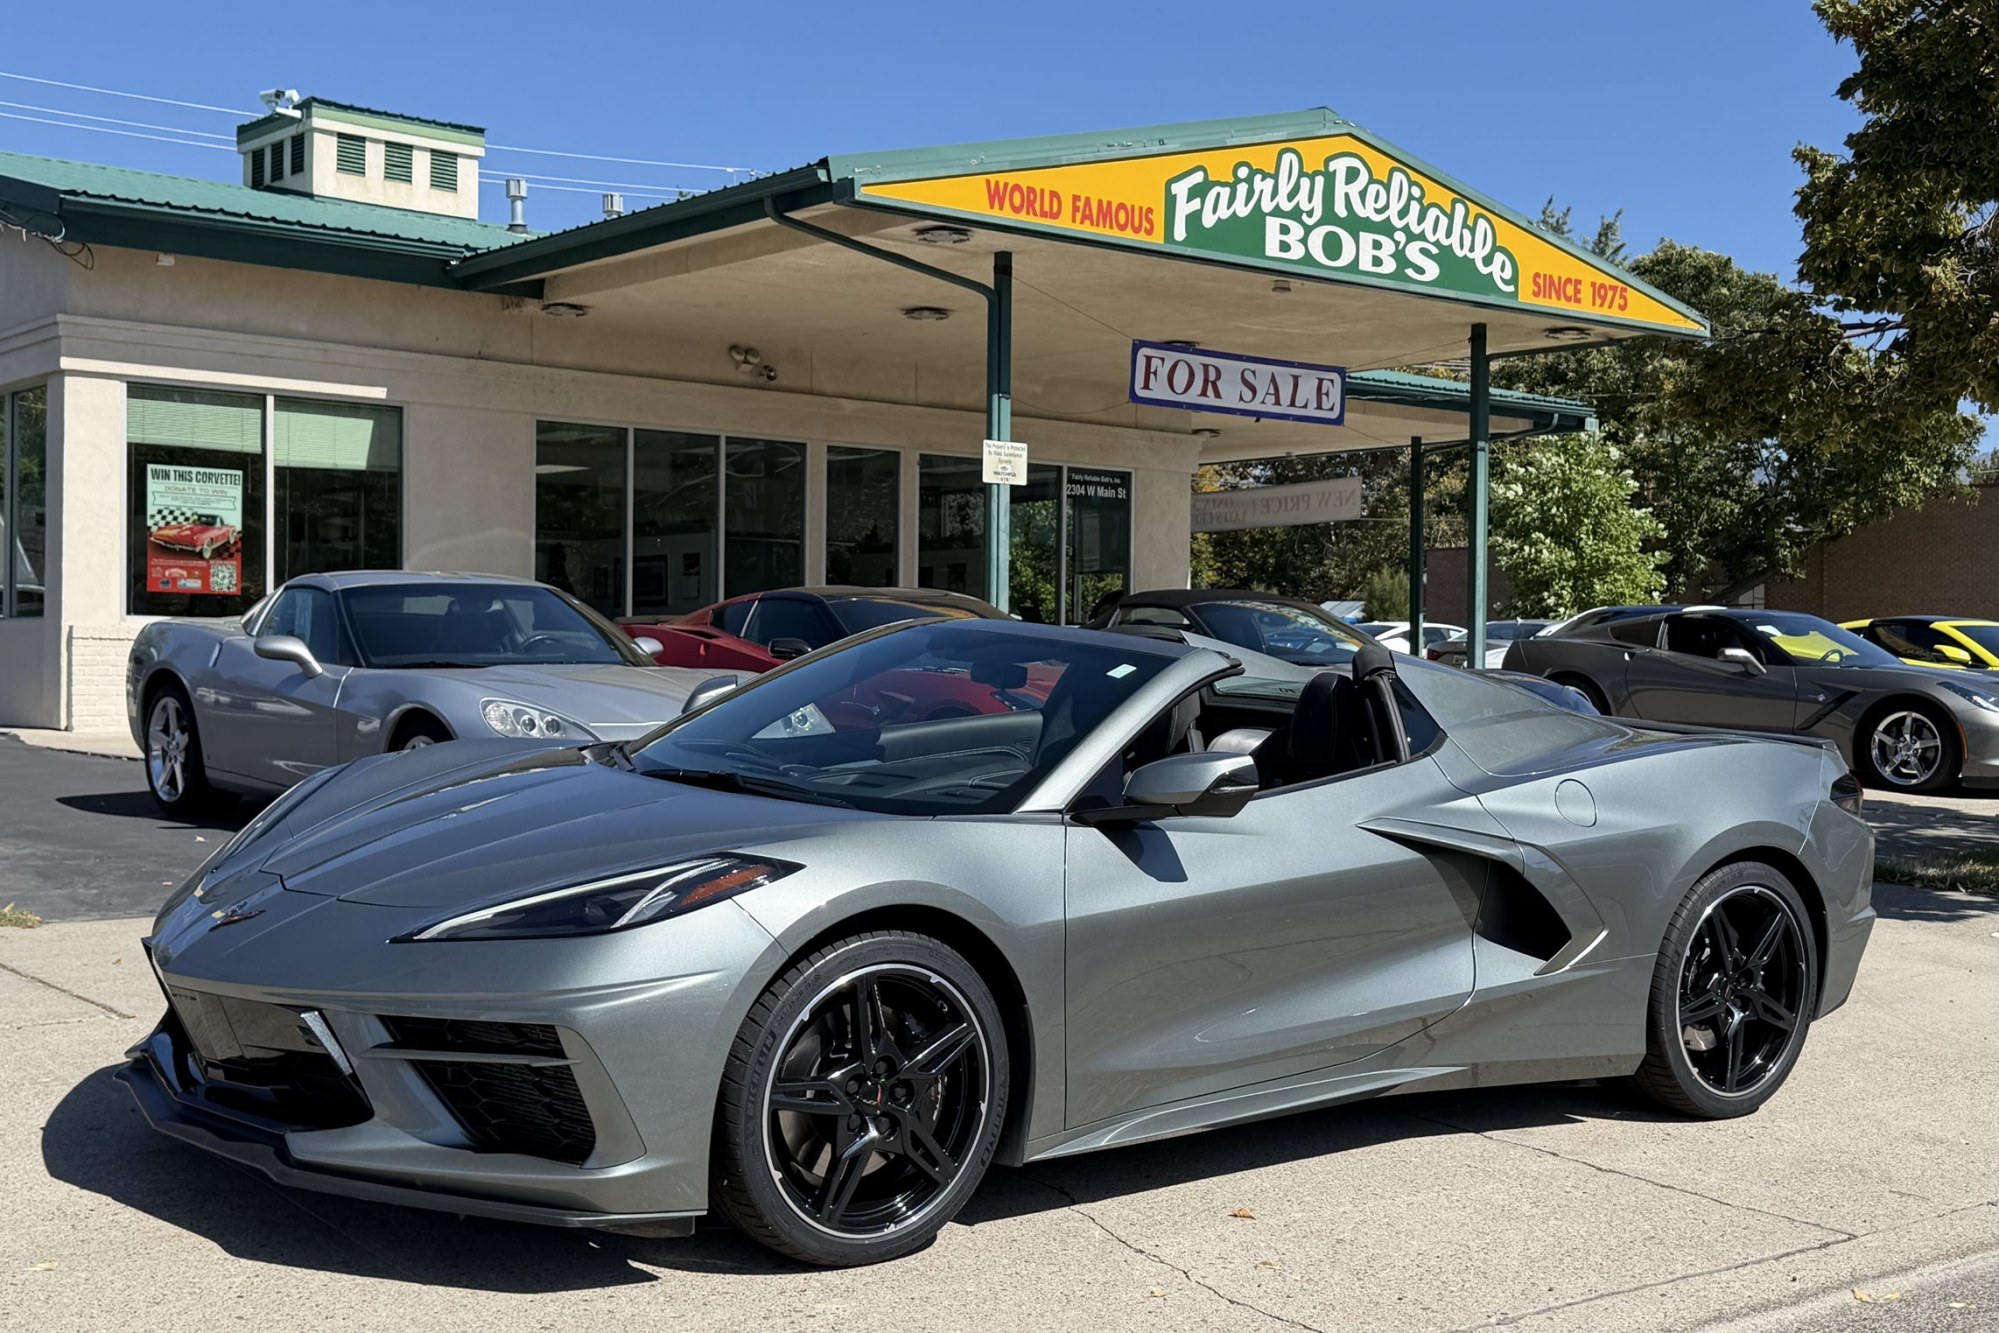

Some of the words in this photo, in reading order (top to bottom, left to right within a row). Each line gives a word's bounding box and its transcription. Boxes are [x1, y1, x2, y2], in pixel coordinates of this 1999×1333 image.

[985, 178, 1062, 220] WORLD
[1071, 194, 1155, 236] FAMOUS
[1170, 152, 1325, 242] Fairly
[1328, 156, 1516, 293] Reliable
[1265, 215, 1440, 282] BOB'S
[1532, 271, 1582, 304] SINCE
[1590, 281, 1628, 311] 1975
[1139, 354, 1223, 400] FOR
[1238, 367, 1336, 412] SALE
[151, 468, 171, 481] WIN
[173, 469, 193, 483] THIS
[195, 471, 241, 486] CORVETTE!
[164, 485, 197, 493] DONATE
[211, 488, 228, 496] WIN
[1066, 484, 1086, 496] 2304
[1086, 485, 1096, 497] W
[1096, 486, 1116, 498] Main
[1117, 487, 1127, 499] St
[745, 1033, 776, 1118] MICHELIN
